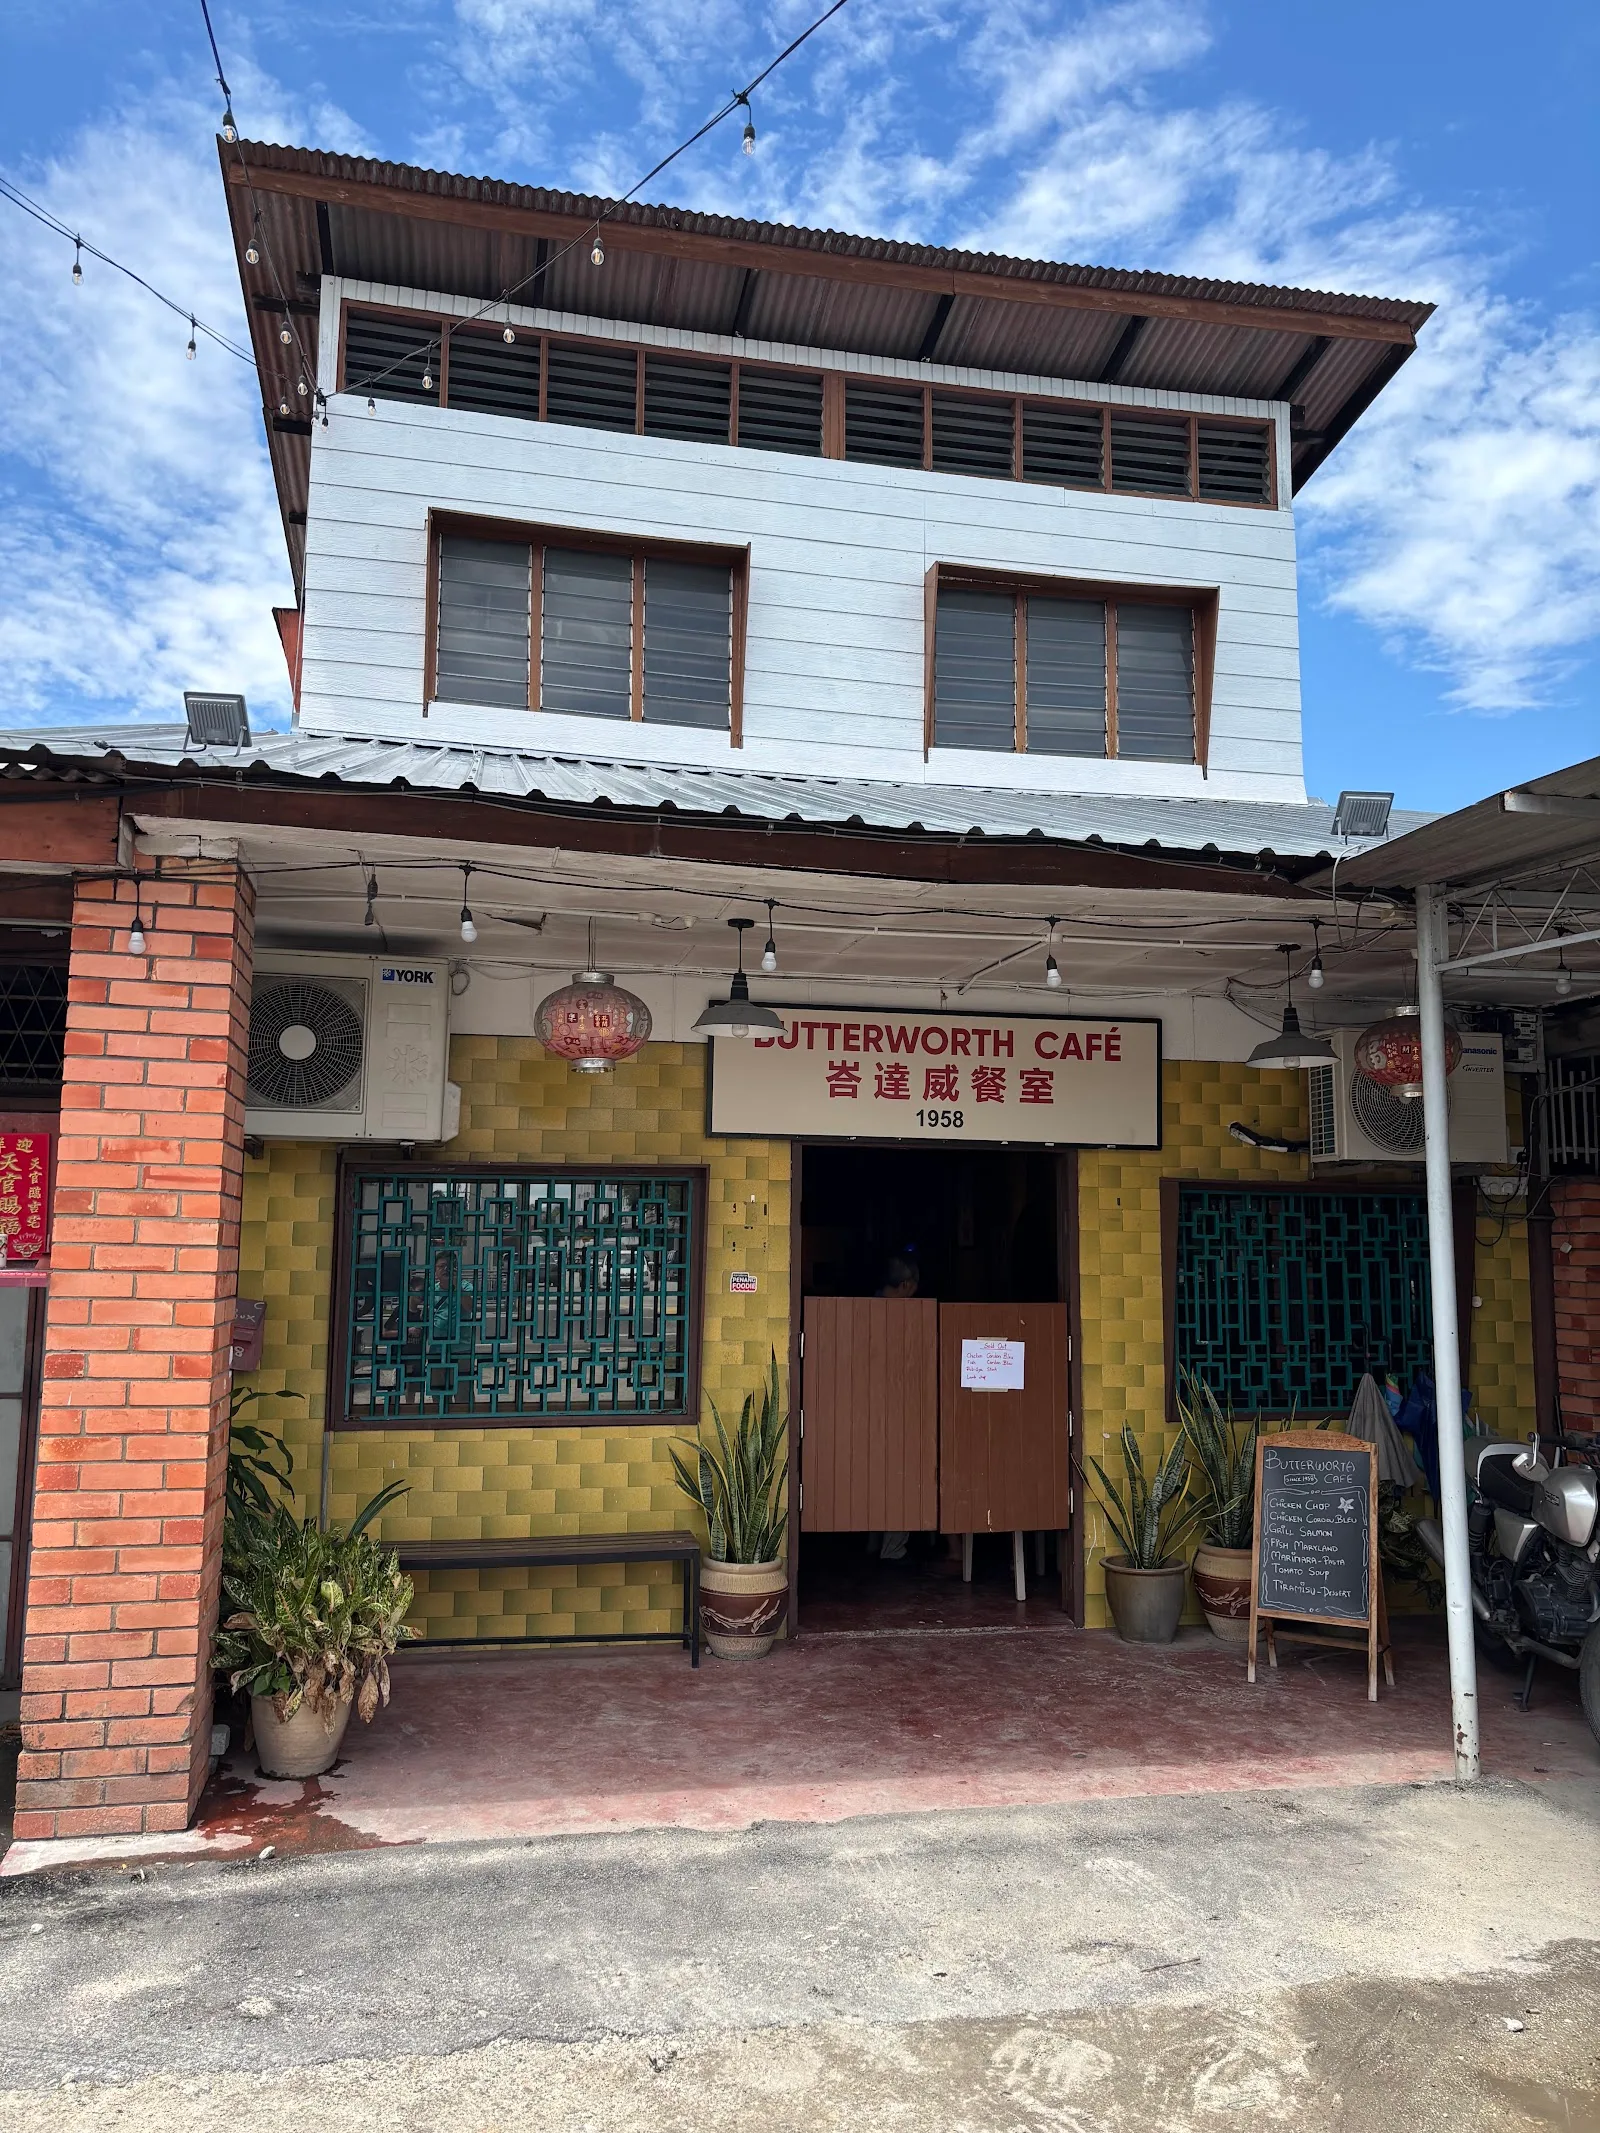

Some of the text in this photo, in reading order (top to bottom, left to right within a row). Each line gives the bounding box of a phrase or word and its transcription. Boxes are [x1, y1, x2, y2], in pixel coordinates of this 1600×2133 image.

[396, 969, 434, 984] YORK
[1034, 1027, 1122, 1062] CAFÉ
[1462, 1047, 1498, 1055] anasonic
[915, 1109, 965, 1128] 1958
